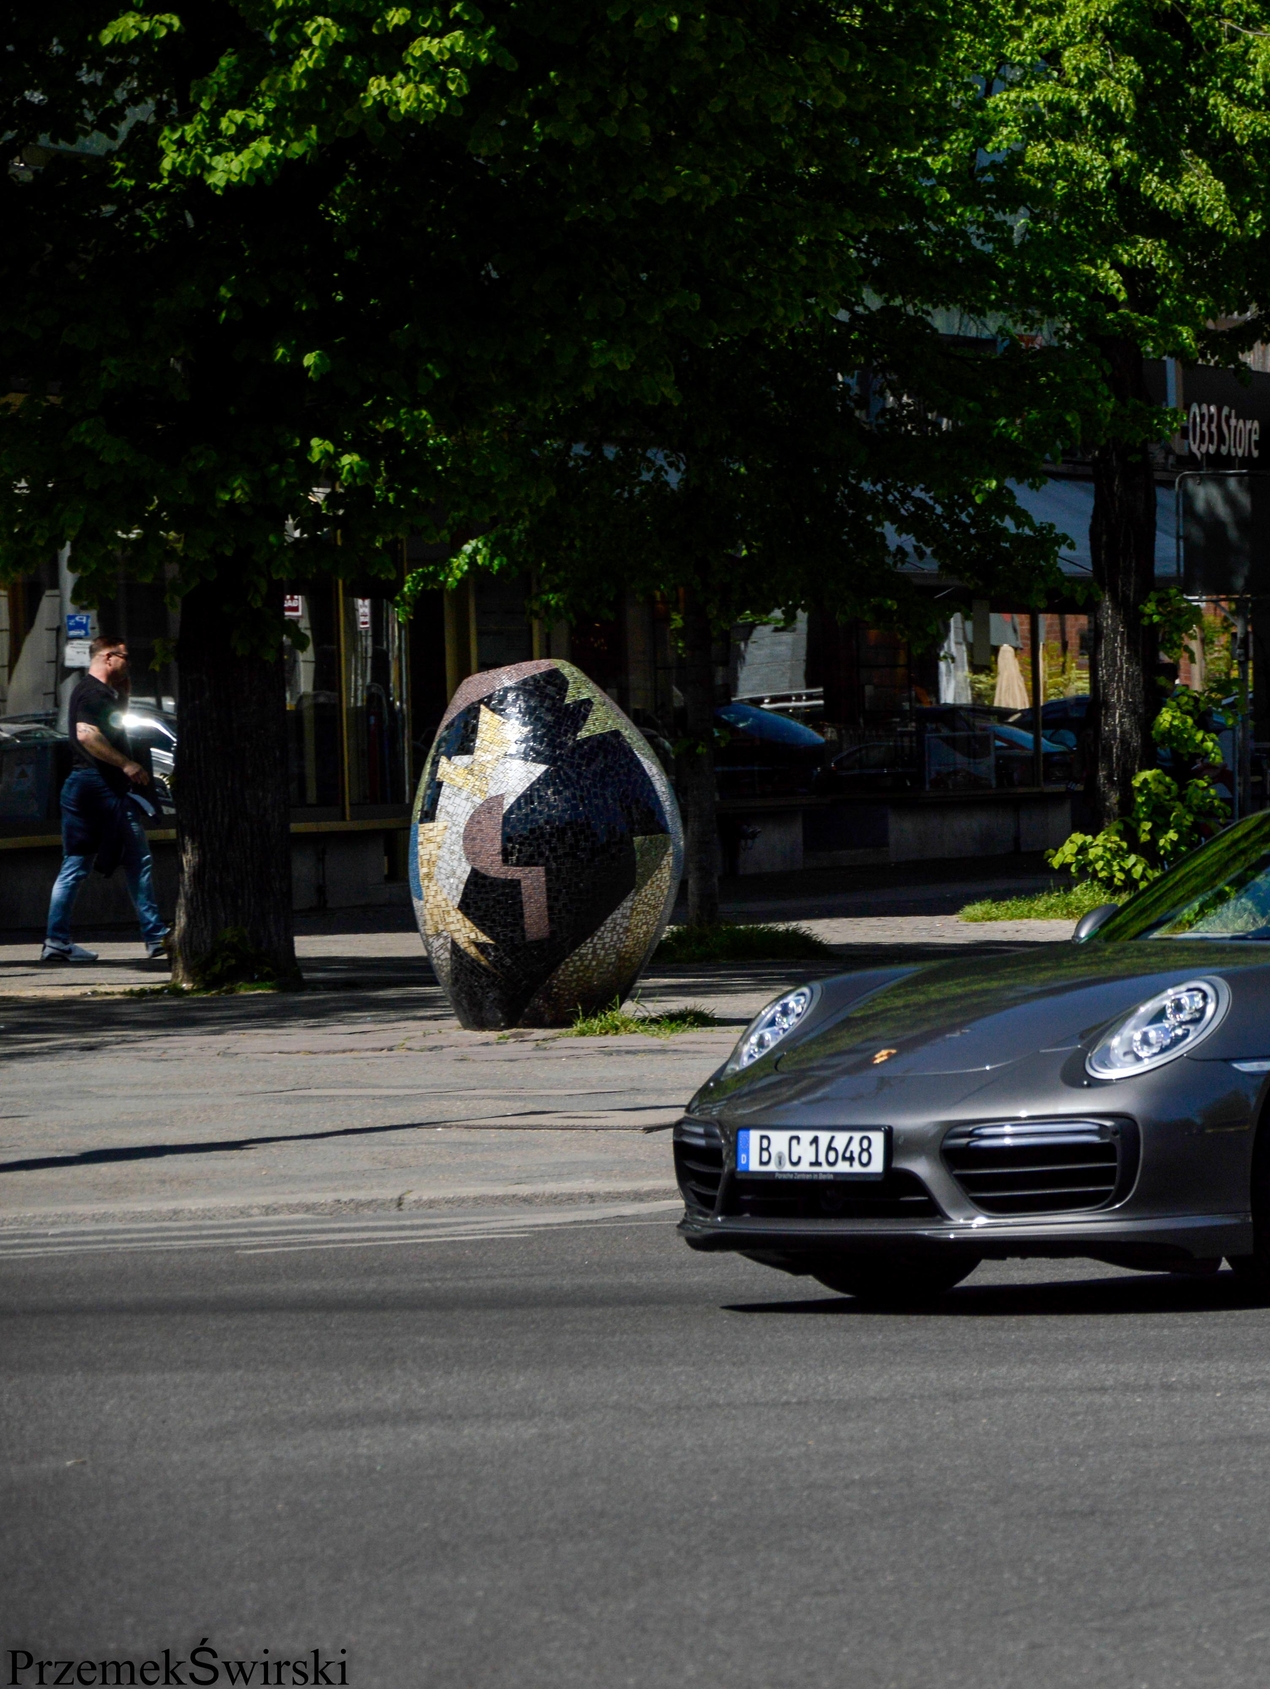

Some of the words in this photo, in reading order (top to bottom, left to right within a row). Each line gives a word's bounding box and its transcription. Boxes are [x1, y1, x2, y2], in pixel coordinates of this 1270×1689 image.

[1188, 402, 1218, 462] Q33
[1219, 405, 1260, 459] Store
[740, 1154, 747, 1165] D
[759, 1135, 772, 1166] B
[788, 1135, 802, 1167] C
[809, 1135, 873, 1168] 1648
